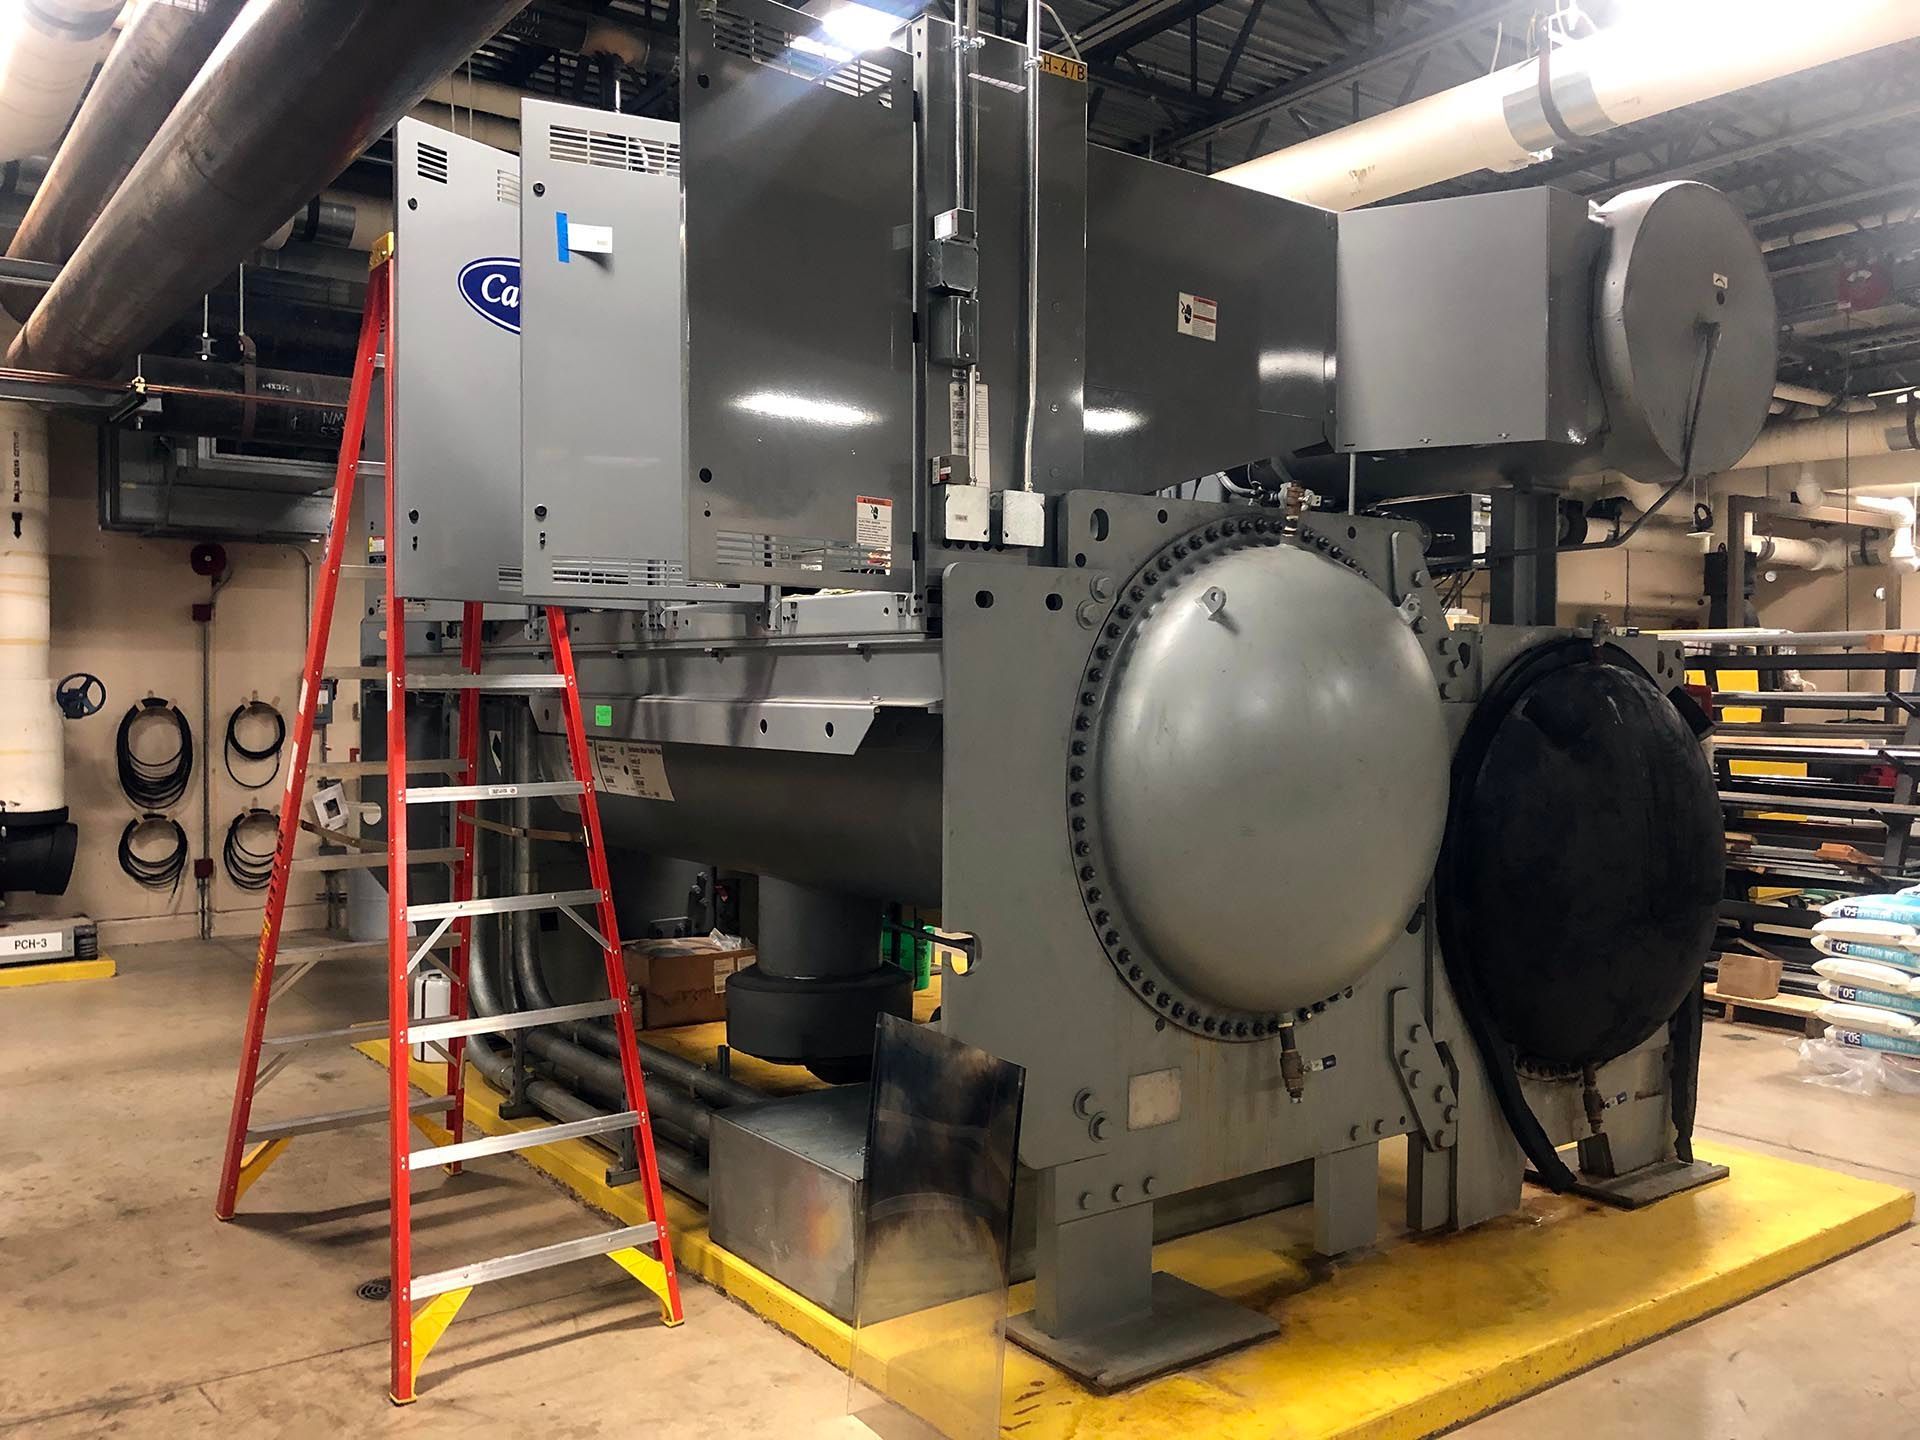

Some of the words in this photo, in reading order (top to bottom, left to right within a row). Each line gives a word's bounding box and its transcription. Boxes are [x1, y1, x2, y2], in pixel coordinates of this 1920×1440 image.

[14, 938, 48, 950] PCH-3
[1835, 941, 1849, 953] 50
[1842, 988, 1856, 999] 50
[1847, 1032, 1861, 1043] 50
